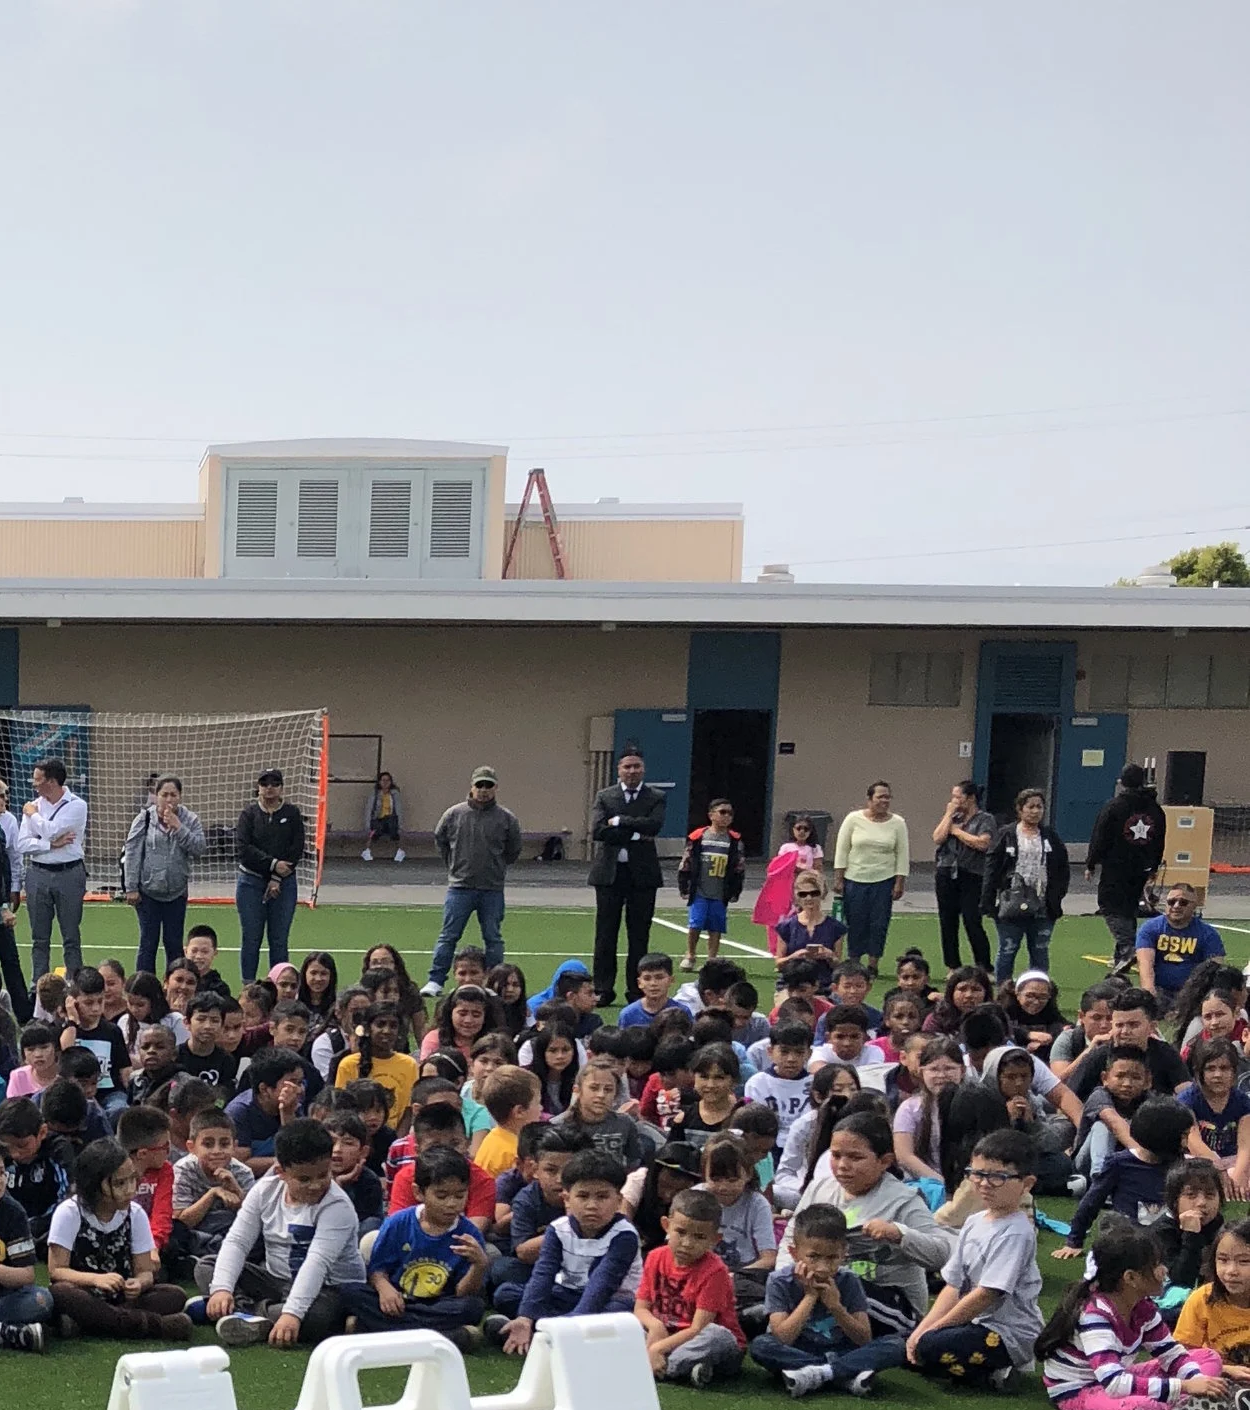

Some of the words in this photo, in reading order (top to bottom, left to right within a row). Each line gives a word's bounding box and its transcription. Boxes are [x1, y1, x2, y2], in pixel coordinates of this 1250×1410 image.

[708, 854, 728, 878] 30
[1157, 934, 1197, 955] GSW
[425, 1272, 443, 1286] 30
